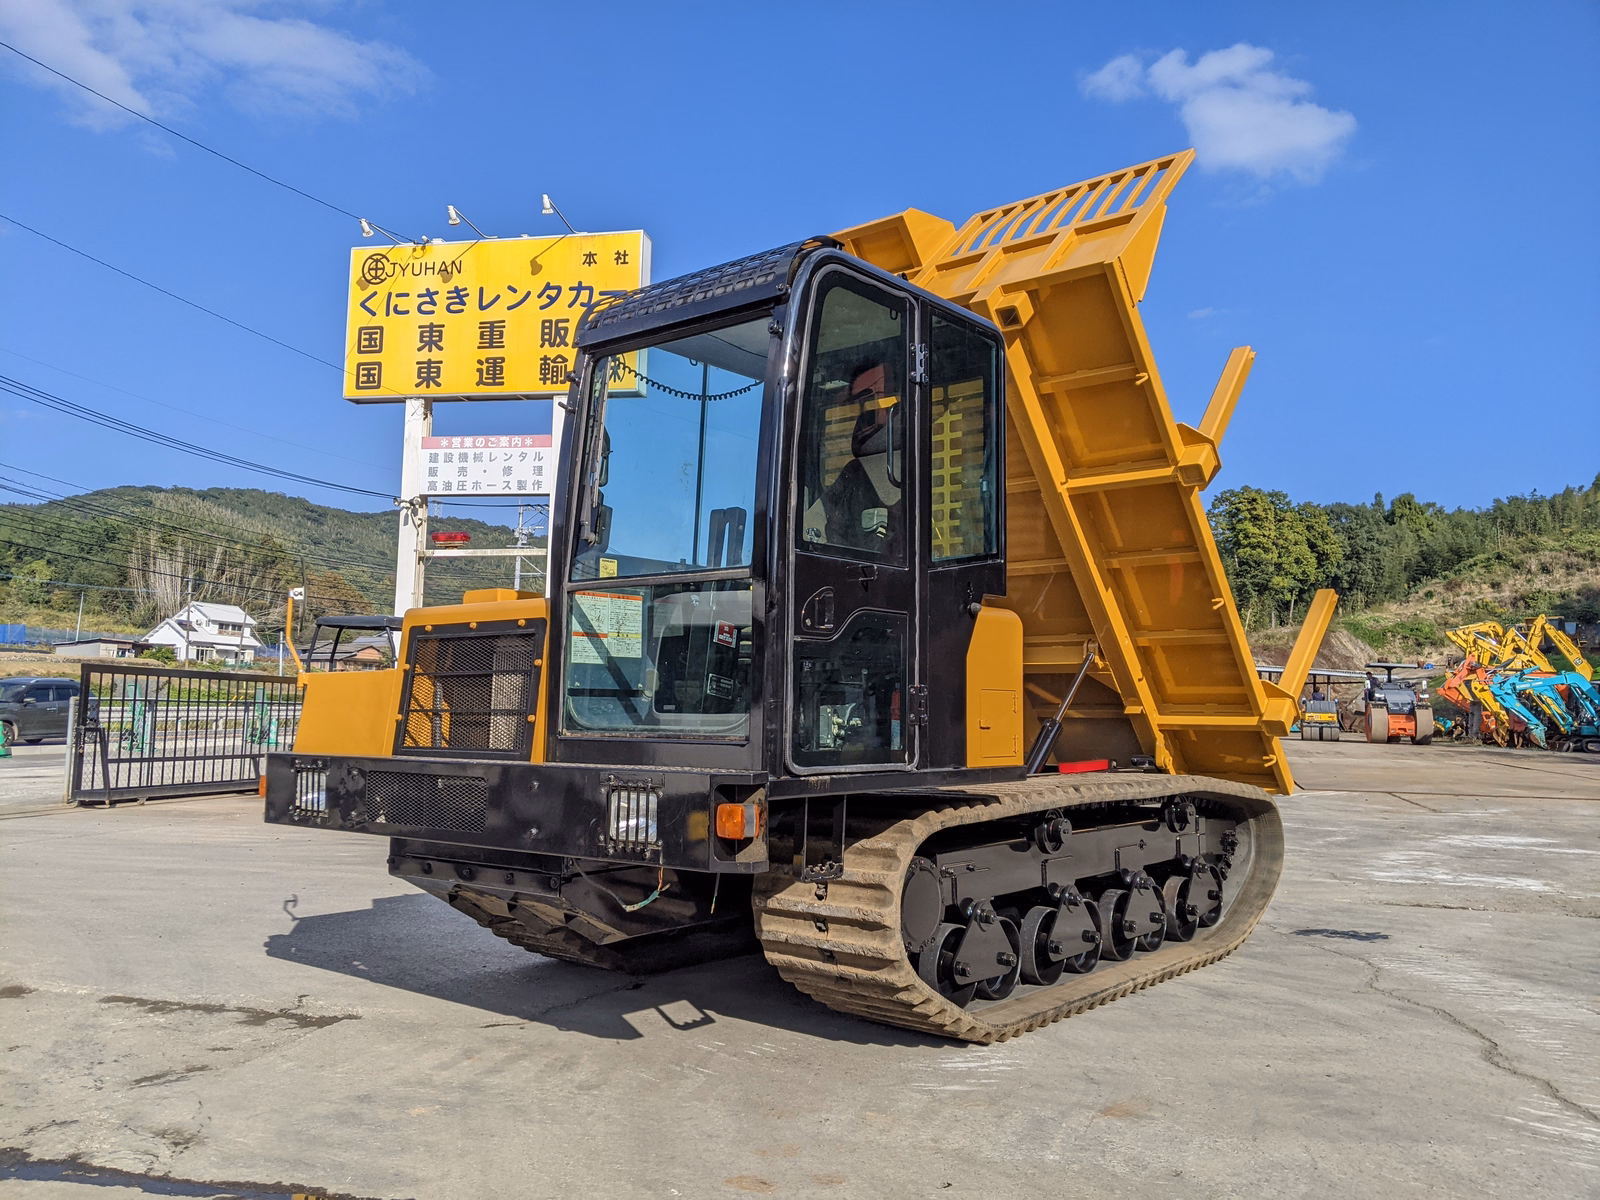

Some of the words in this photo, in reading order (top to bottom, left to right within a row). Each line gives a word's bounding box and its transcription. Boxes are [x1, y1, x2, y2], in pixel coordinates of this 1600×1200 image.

[582, 250, 629, 267] 本社
[385, 260, 462, 278] JYUHAN
[359, 281, 627, 316] くにさきレンタカー
[357, 319, 570, 354] 国東重販
[428, 451, 544, 464] 建設機械レンタル
[427, 480, 543, 492] 高油圧ホース製作
